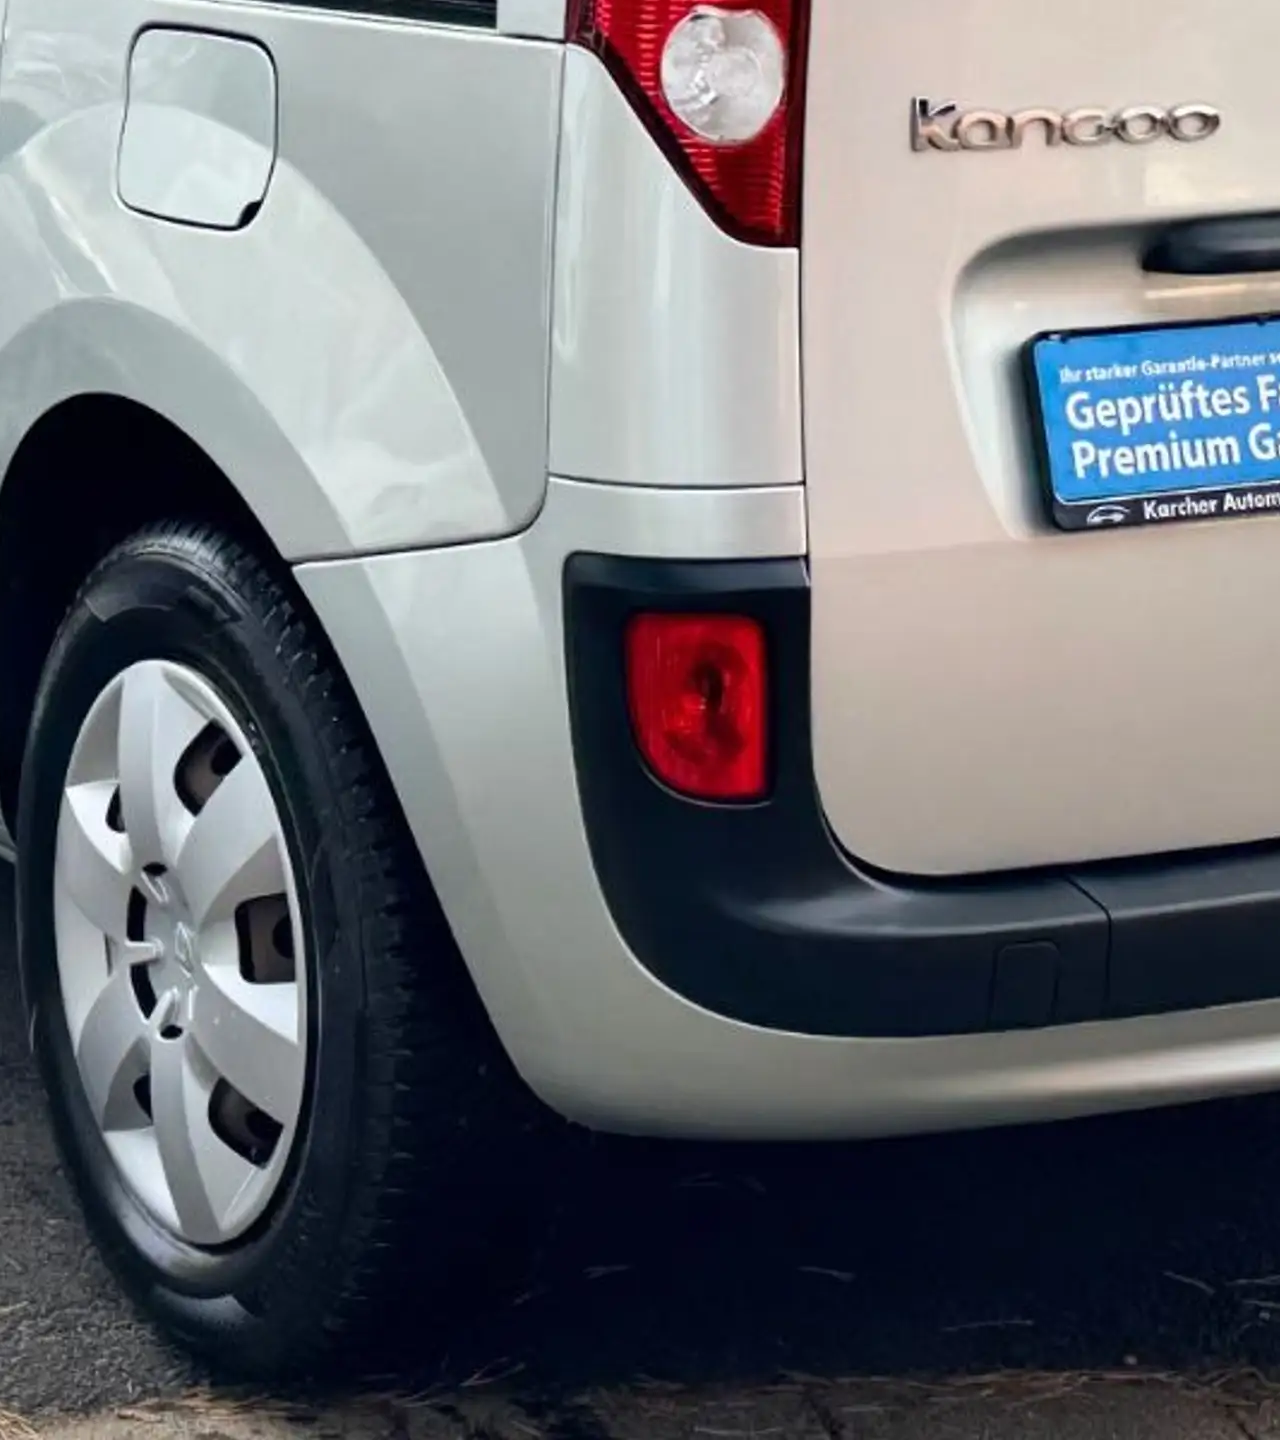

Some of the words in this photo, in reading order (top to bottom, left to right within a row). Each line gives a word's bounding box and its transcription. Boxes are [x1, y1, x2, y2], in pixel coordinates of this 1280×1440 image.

[1084, 363, 1138, 382] starker
[1140, 353, 1266, 377] Garantie-Partner
[1064, 378, 1251, 436] Geprüftes
[1071, 429, 1242, 479] Premium
[1143, 496, 1218, 520] Karcher
